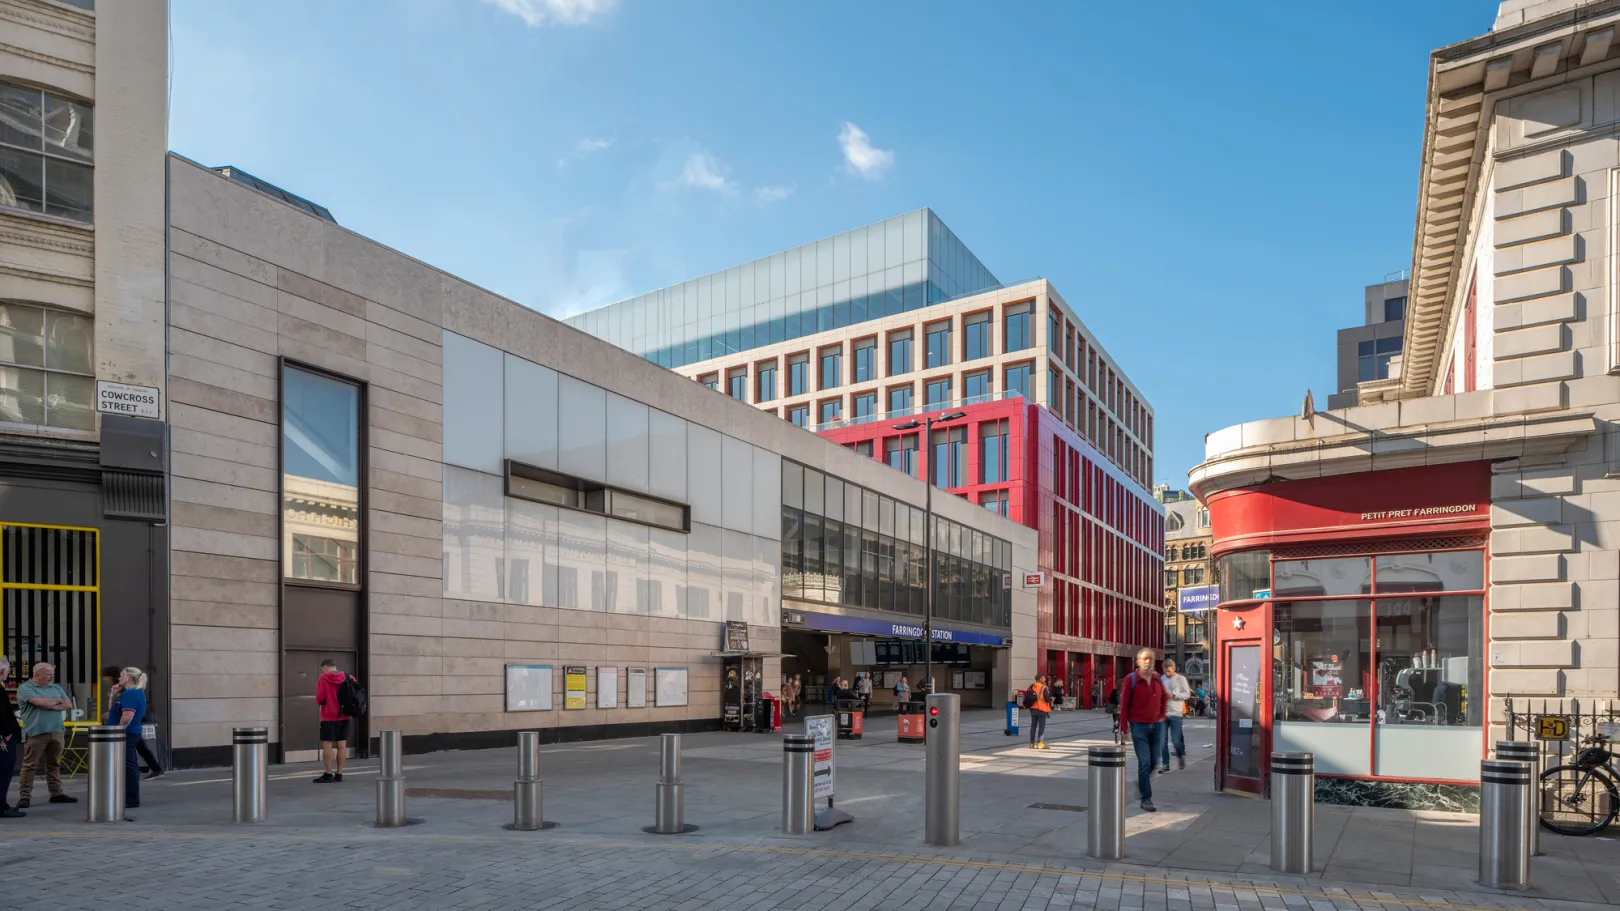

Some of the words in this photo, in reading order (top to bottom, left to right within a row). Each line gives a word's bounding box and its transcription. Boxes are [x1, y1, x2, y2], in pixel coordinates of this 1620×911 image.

[101, 390, 155, 404] COWCROSS
[101, 401, 138, 412] STREET
[1361, 511, 1386, 520] PETIT
[1388, 509, 1412, 518] PRET
[1414, 504, 1476, 516] FARRINGDON
[1183, 593, 1220, 604] FARRINGD
[892, 625, 927, 637] FARRINGD
[931, 629, 953, 640] STATION
